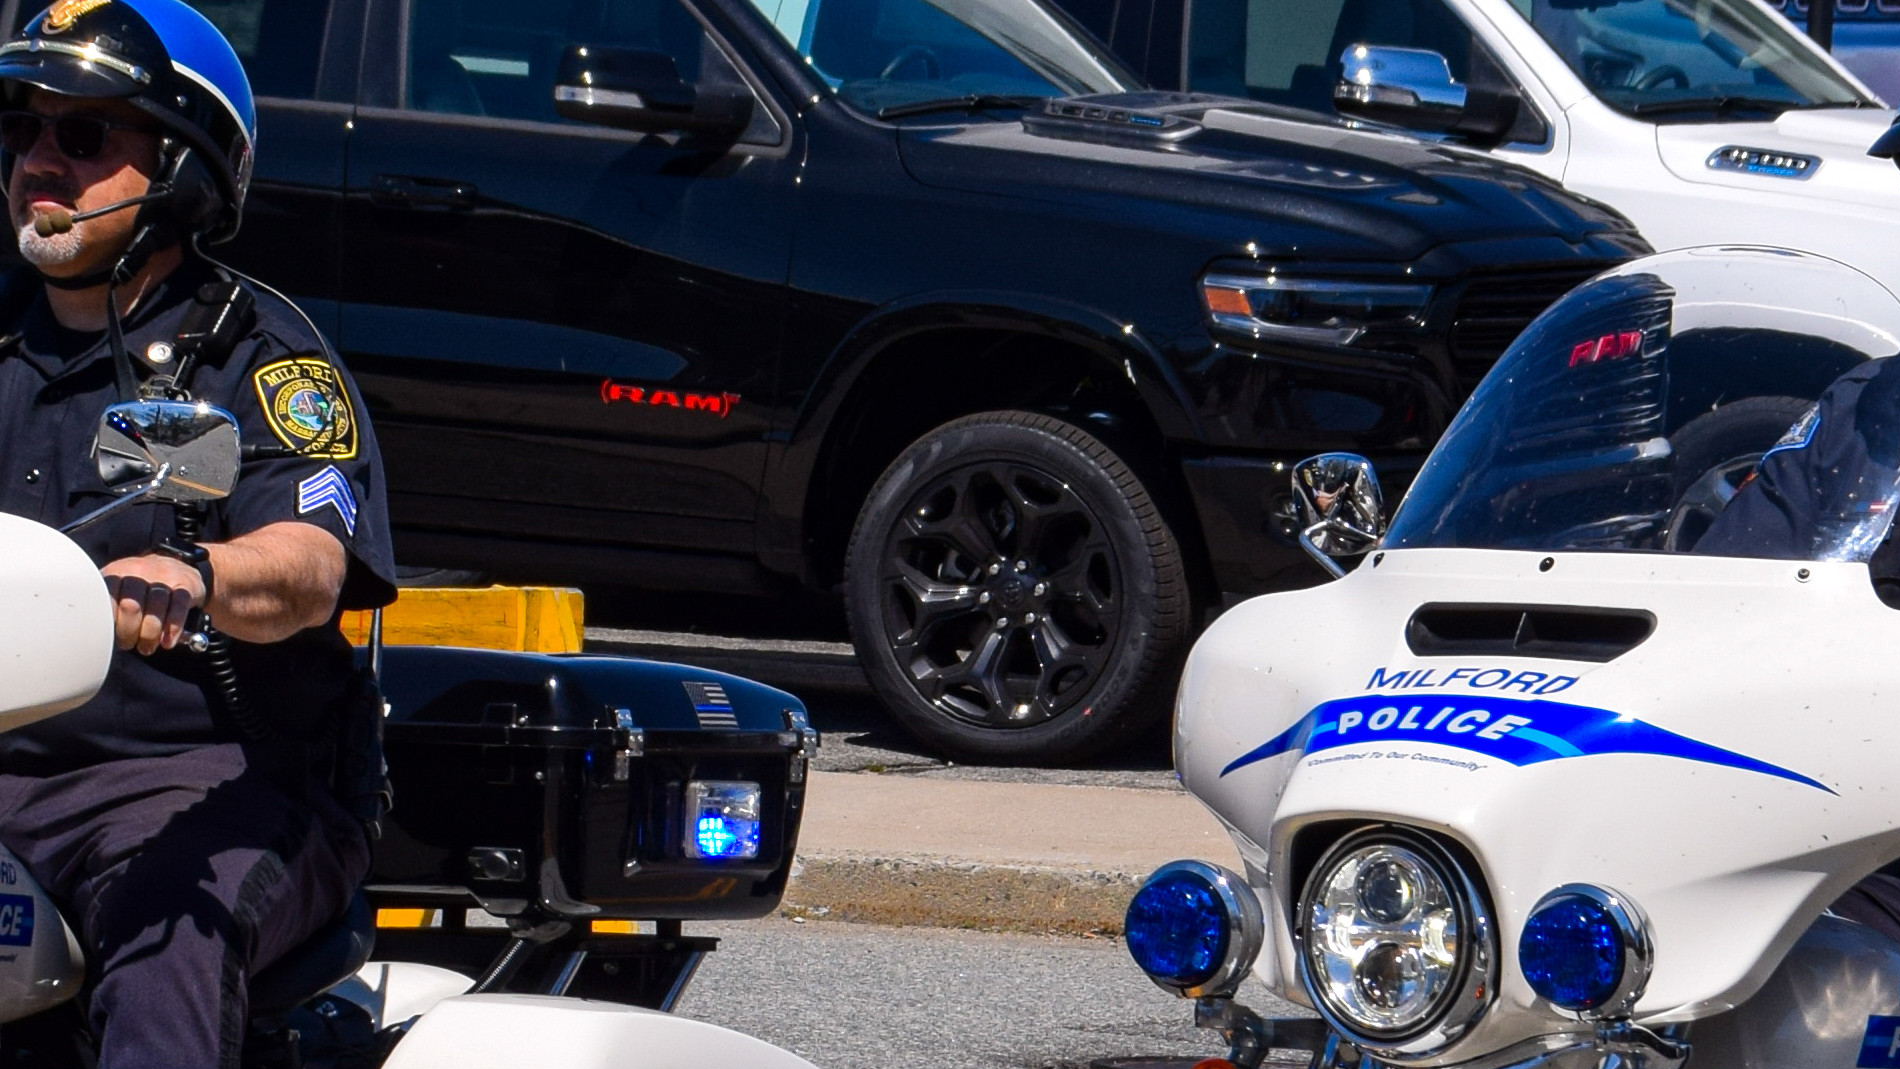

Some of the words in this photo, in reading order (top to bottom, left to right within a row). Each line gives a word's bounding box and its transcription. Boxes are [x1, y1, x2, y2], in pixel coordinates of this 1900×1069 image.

[1568, 327, 1643, 369] RAM
[608, 383, 722, 412] RAM
[1365, 667, 1581, 695] MILFORD
[1338, 706, 1533, 740] POLICE
